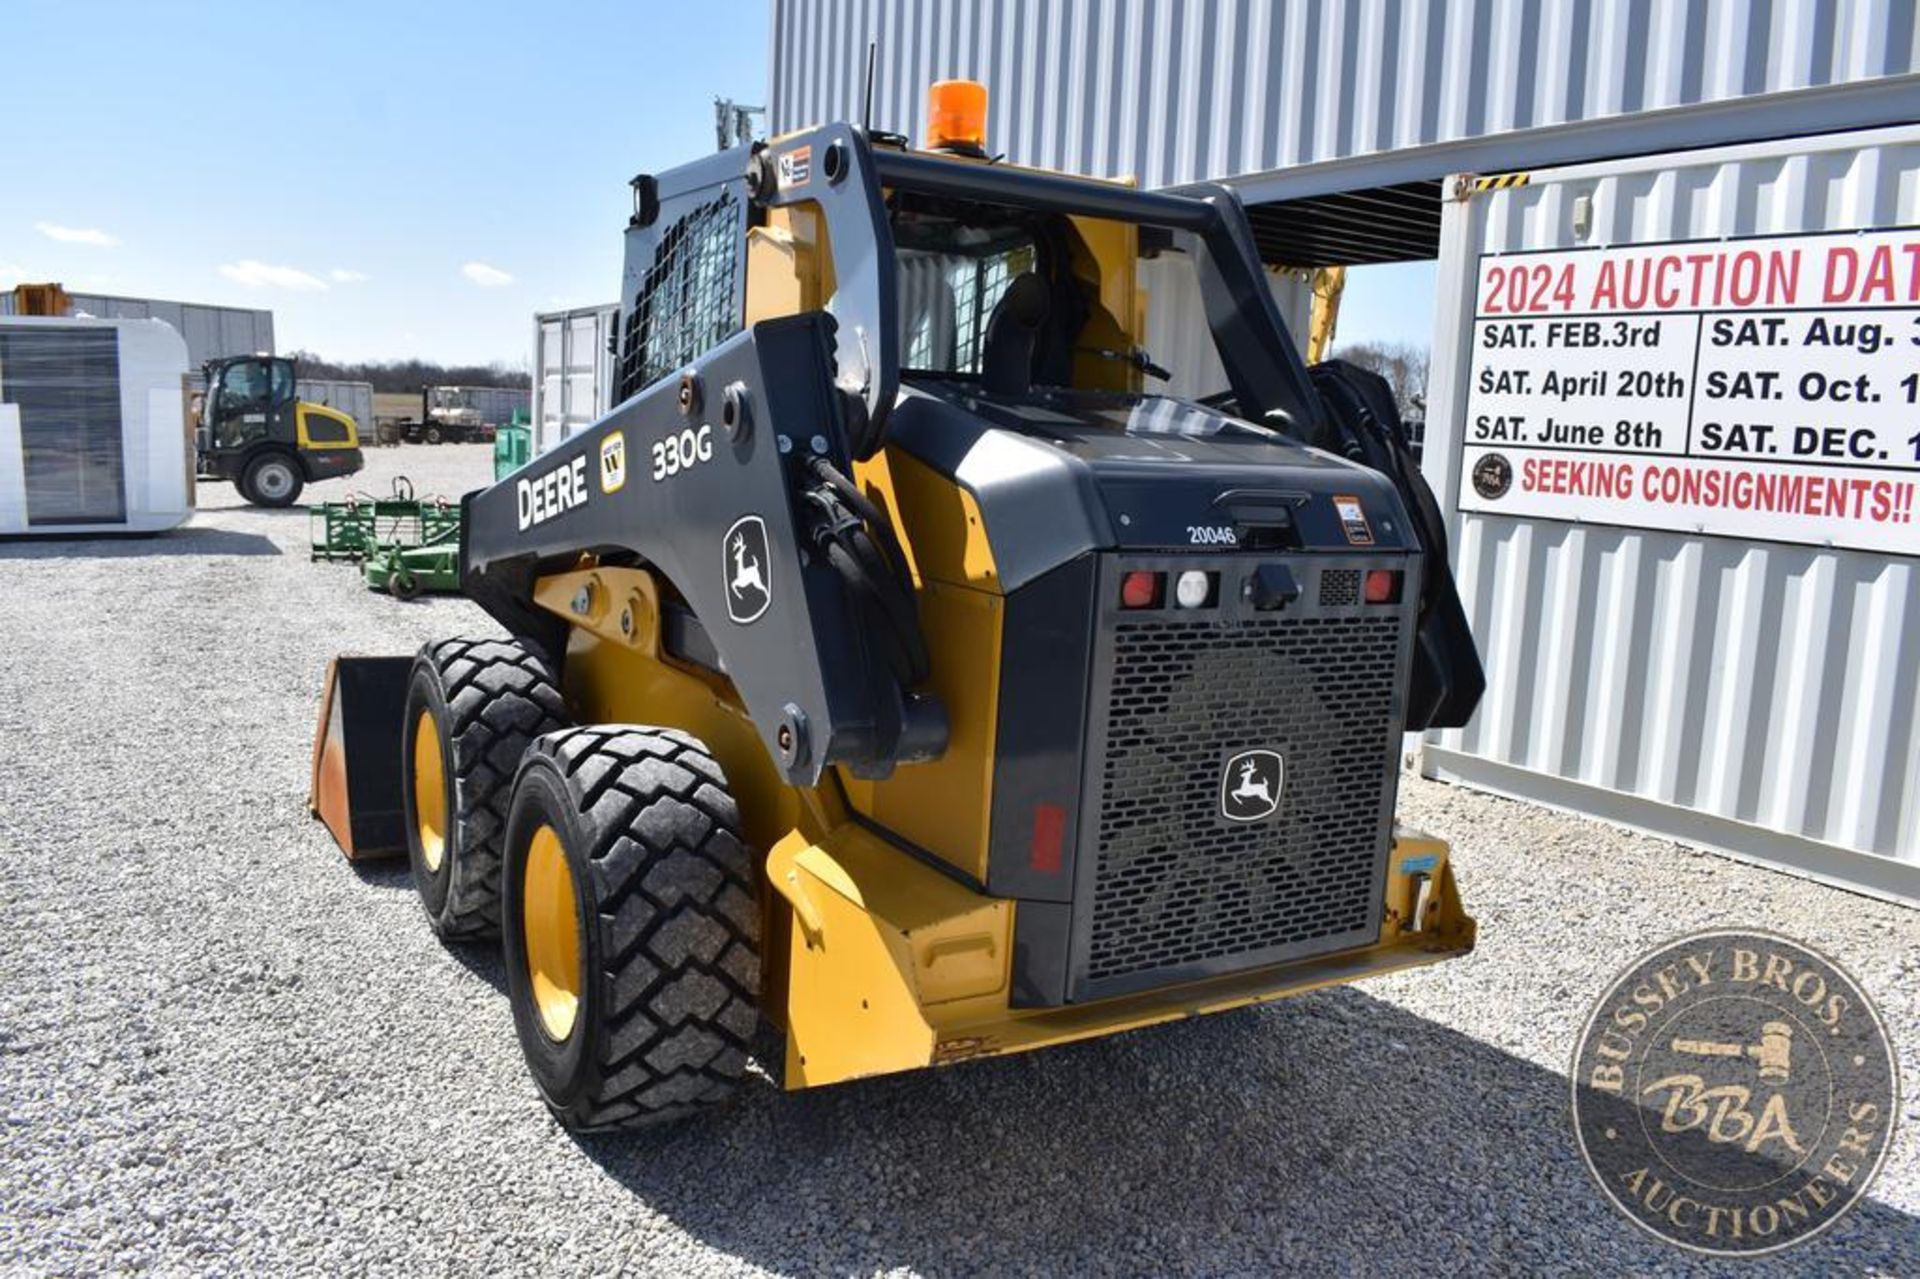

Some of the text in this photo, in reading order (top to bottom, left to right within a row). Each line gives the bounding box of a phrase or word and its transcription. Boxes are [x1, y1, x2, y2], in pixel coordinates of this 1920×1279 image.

[1484, 263, 1575, 314] 2024
[1590, 249, 1801, 310] AUCTION
[1483, 321, 1661, 348] SAT. FEB.3rd
[1711, 318, 1789, 346] SAT.
[1803, 317, 1894, 354] Aug.
[1479, 368, 1684, 401] SAT. April 20th
[1706, 371, 1783, 400] SAT.
[1798, 372, 1881, 403] Oct.
[1475, 415, 1662, 448] SAT. June 8th
[1701, 422, 1777, 453] SAT.
[1793, 426, 1888, 460] DEC.
[652, 425, 712, 481] 330G
[517, 455, 588, 531] DEERE
[1522, 458, 1633, 500] SEEKING
[1642, 465, 1914, 523] CONSIGNMENTS!!
[1186, 526, 1236, 544] 20046
